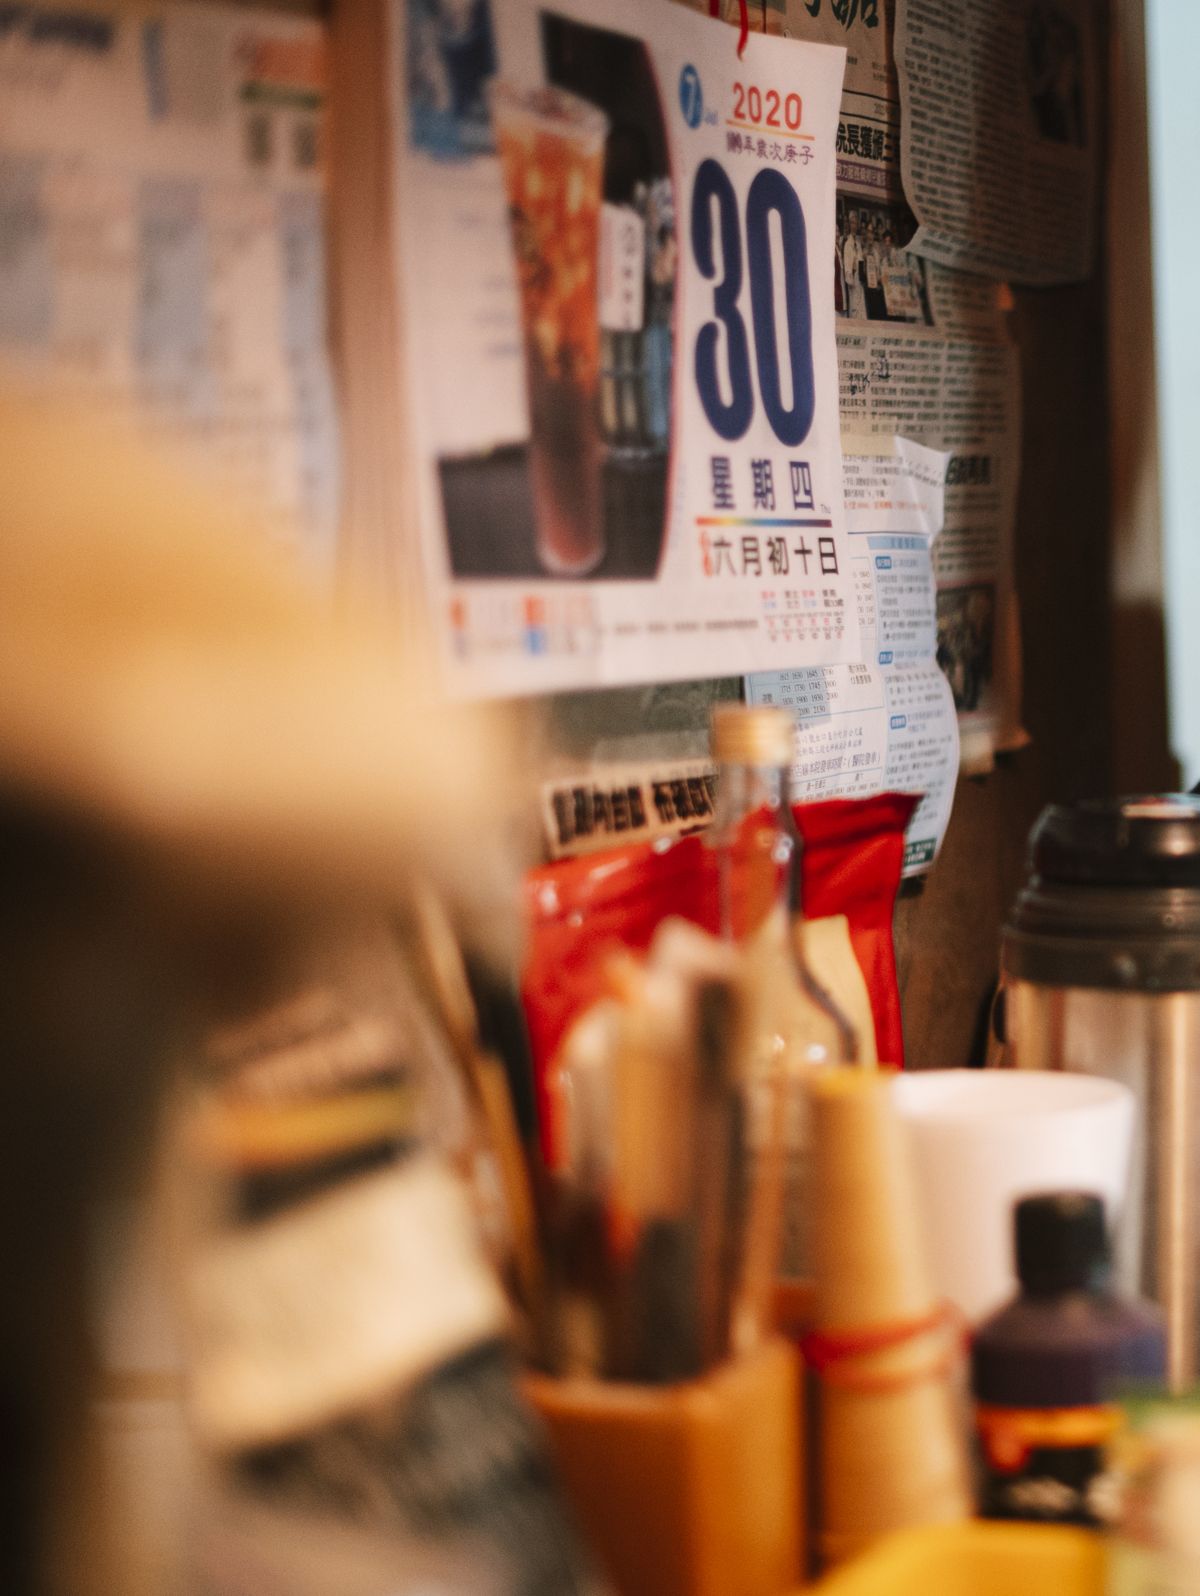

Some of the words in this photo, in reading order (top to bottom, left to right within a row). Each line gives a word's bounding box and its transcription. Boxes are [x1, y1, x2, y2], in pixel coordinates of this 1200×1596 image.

[732, 82, 803, 130] 2020
[690, 157, 815, 447] 30
[710, 455, 815, 511] 星期四
[712, 535, 839, 576] 六月初十日
